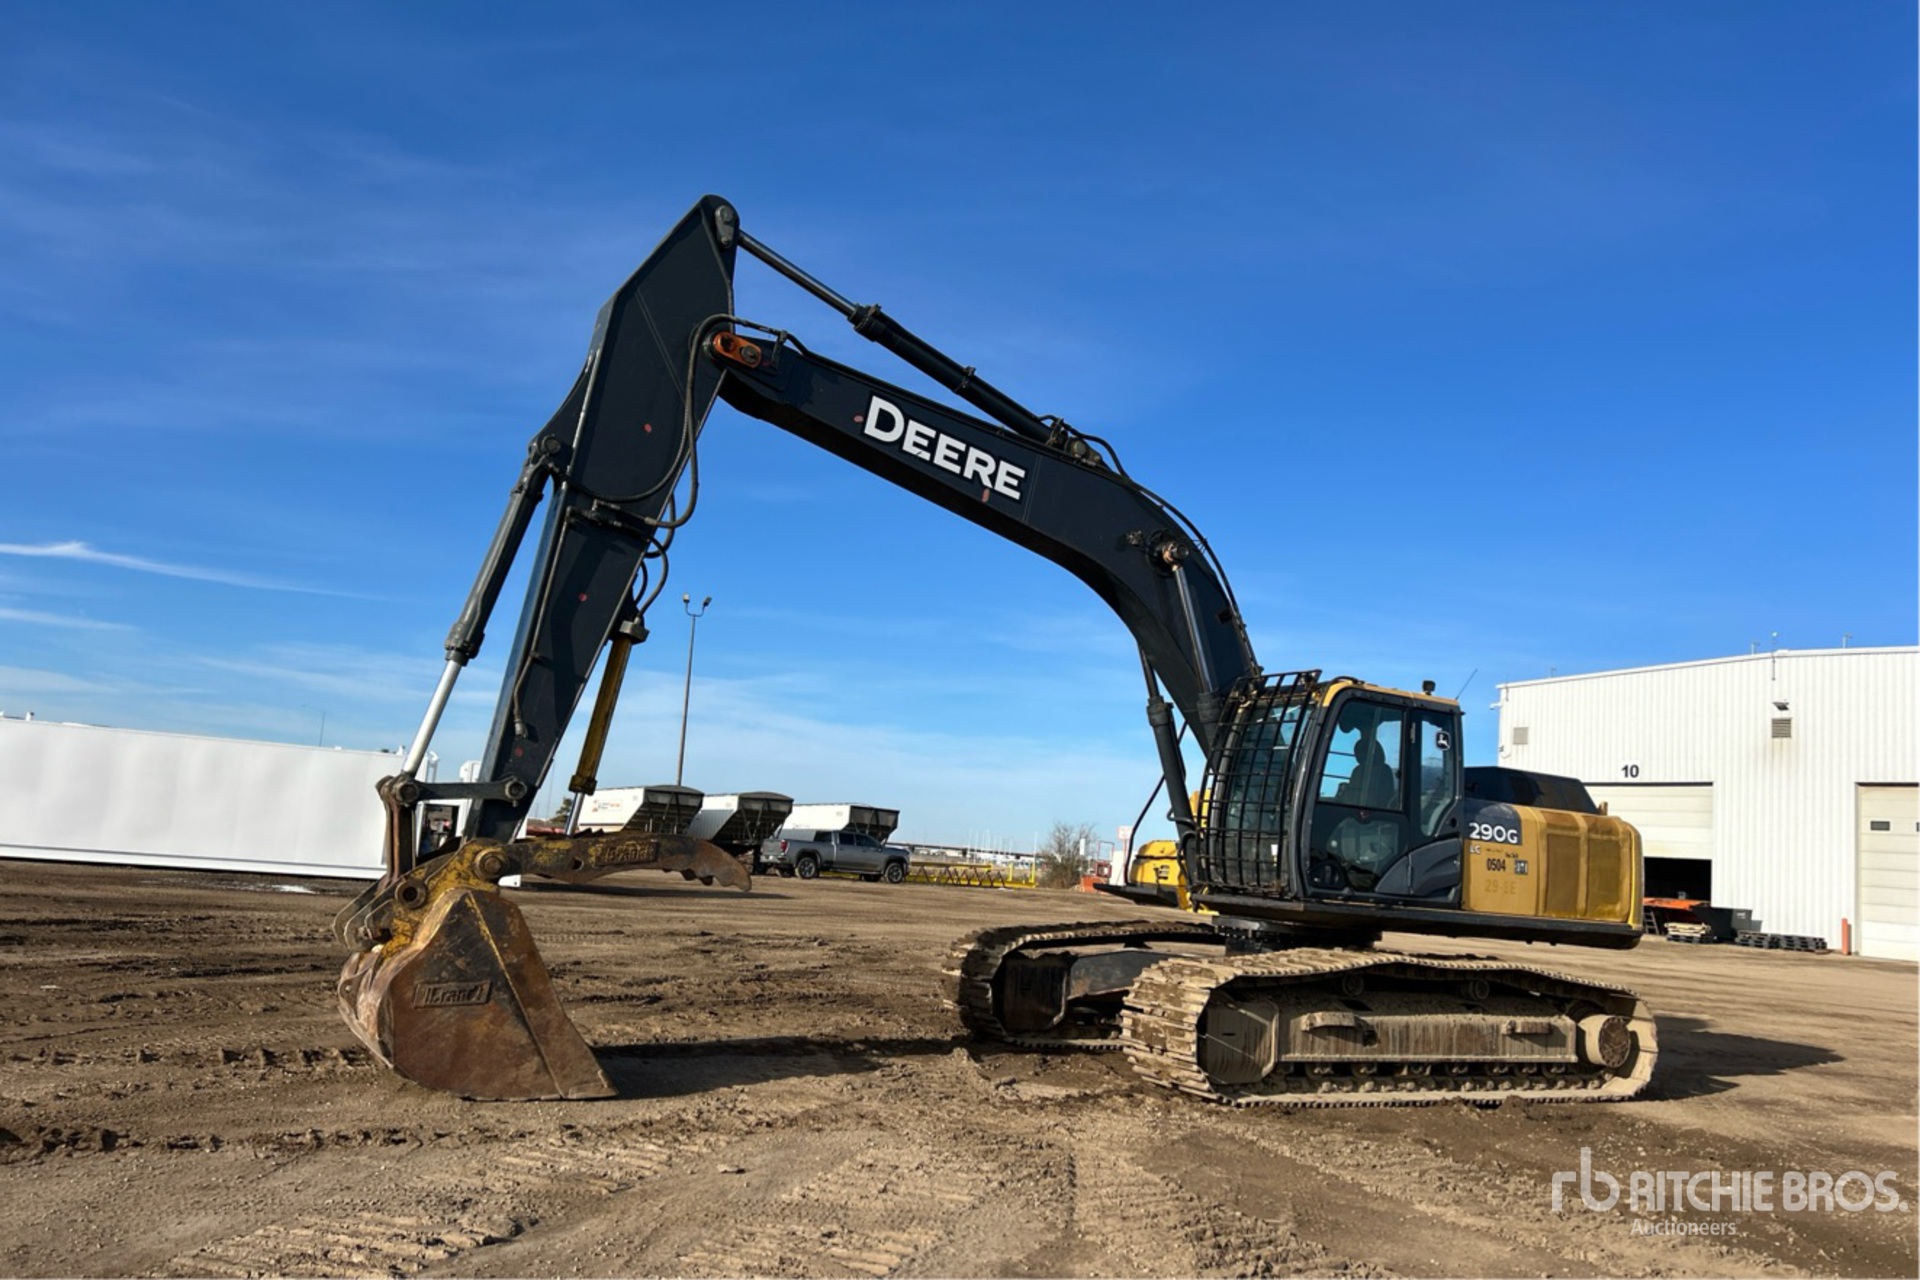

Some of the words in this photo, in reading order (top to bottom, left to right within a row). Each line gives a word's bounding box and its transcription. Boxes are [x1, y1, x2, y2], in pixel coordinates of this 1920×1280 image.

[864, 395, 1026, 500] DEERE
[1621, 764, 1640, 778] 10
[1469, 822, 1518, 844] 290G
[1487, 858, 1506, 872] 0504
